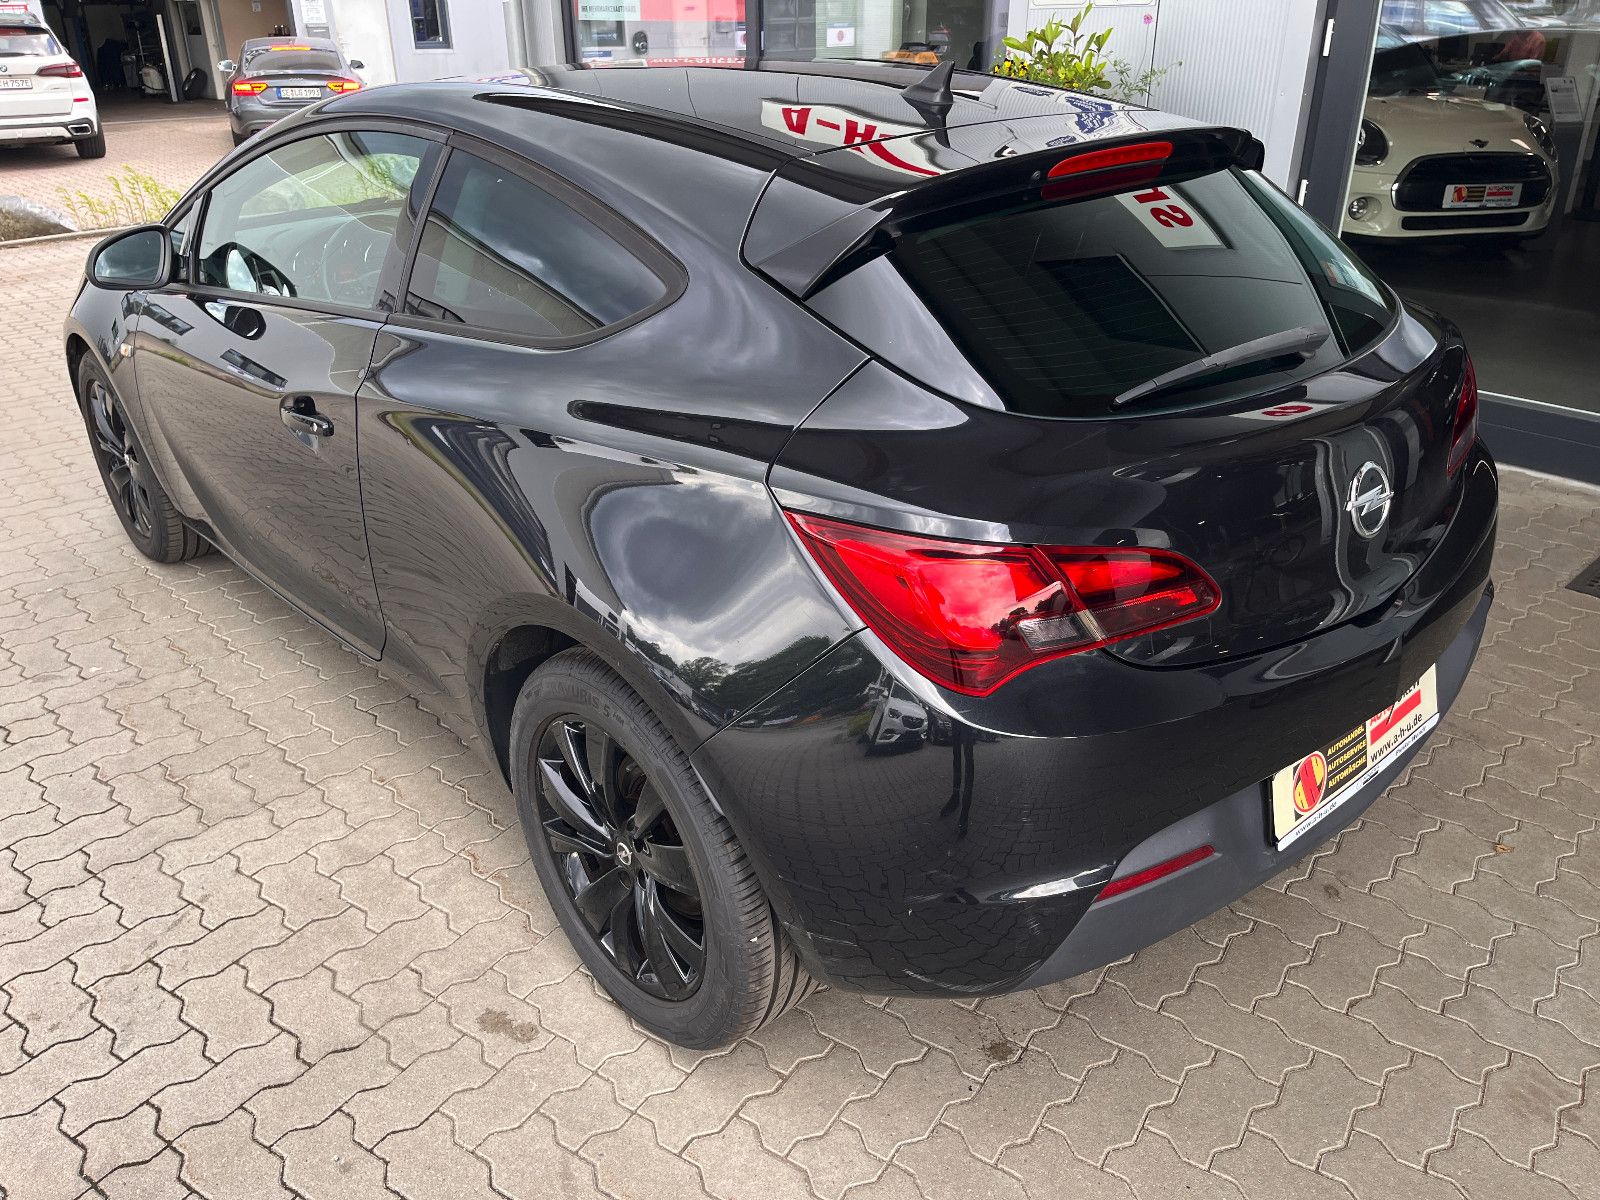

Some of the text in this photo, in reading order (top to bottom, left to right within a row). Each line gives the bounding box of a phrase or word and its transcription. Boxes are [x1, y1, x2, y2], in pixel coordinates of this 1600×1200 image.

[1327, 724, 1365, 756] AUTOHANDEL
[1370, 713, 1423, 763] www.a-h-u.de
[1327, 739, 1367, 772] AUTOSERVICE
